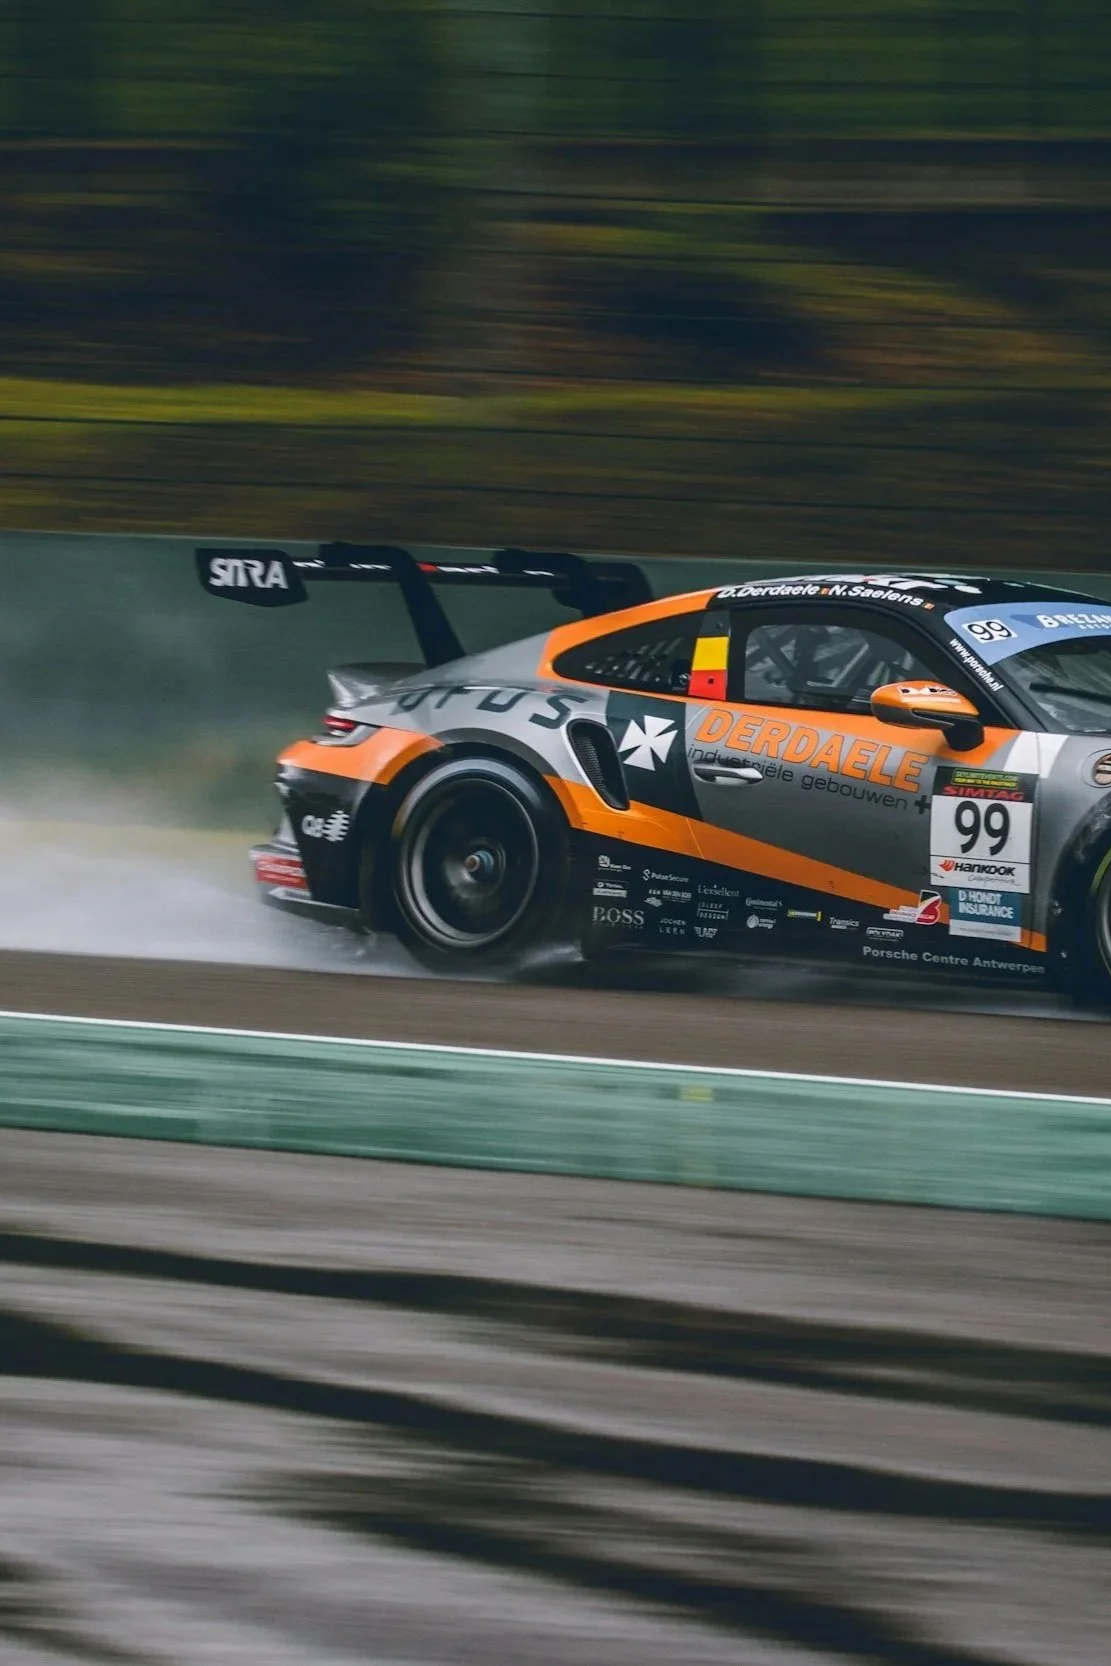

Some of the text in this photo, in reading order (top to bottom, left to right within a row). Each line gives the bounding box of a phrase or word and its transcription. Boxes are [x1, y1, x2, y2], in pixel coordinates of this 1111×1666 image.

[967, 621, 1013, 641] 99
[949, 638, 1005, 692] www.porsche.nl
[694, 708, 930, 793] DERDAELE
[801, 773, 908, 809] gebouwen
[943, 785, 1025, 800] SIMTAG
[955, 800, 1010, 856] 99
[592, 906, 645, 925] BOSS
[699, 911, 726, 920] DESIGN
[958, 902, 1014, 919] INSURANCE
[659, 926, 686, 935] LEEN
[862, 945, 1046, 974] Porsche Centre Antwerpen
